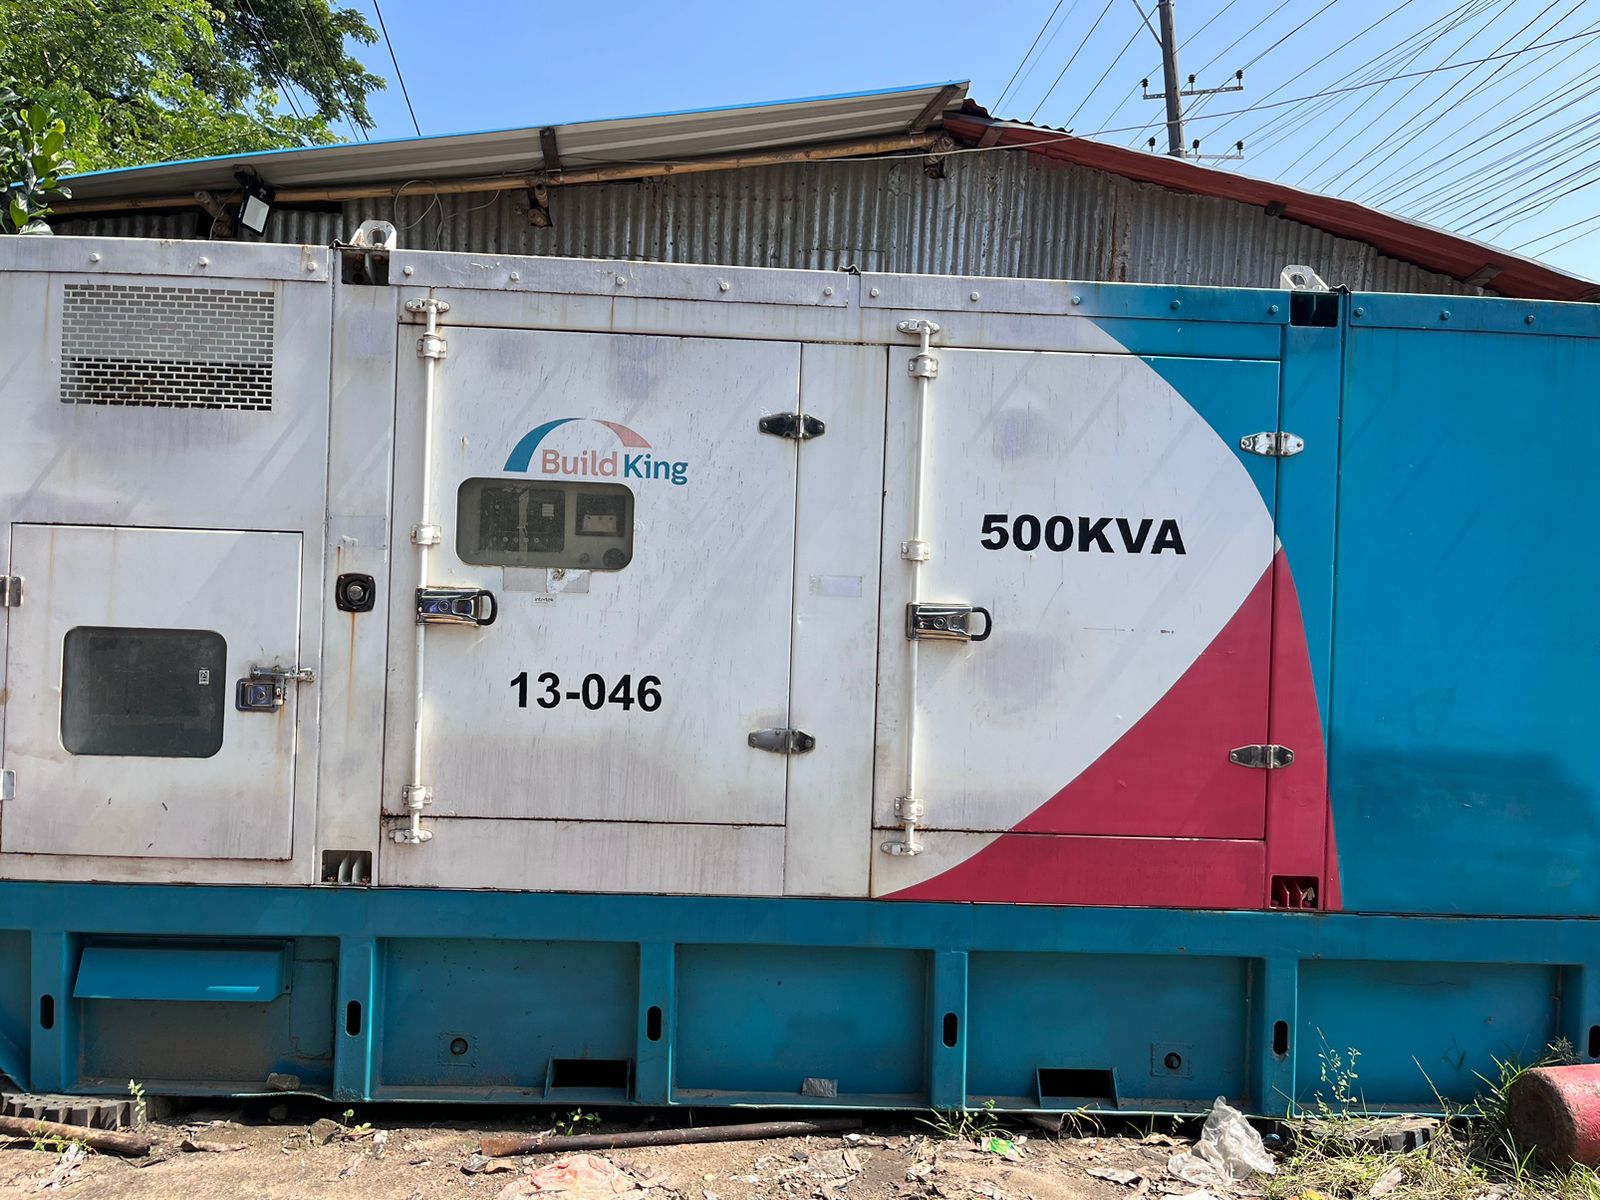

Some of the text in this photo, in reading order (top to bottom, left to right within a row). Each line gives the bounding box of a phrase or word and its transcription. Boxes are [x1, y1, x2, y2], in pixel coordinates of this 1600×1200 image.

[541, 449, 688, 485] Build King
[980, 514, 1187, 555] 500KVA
[510, 671, 662, 712] 13-046
